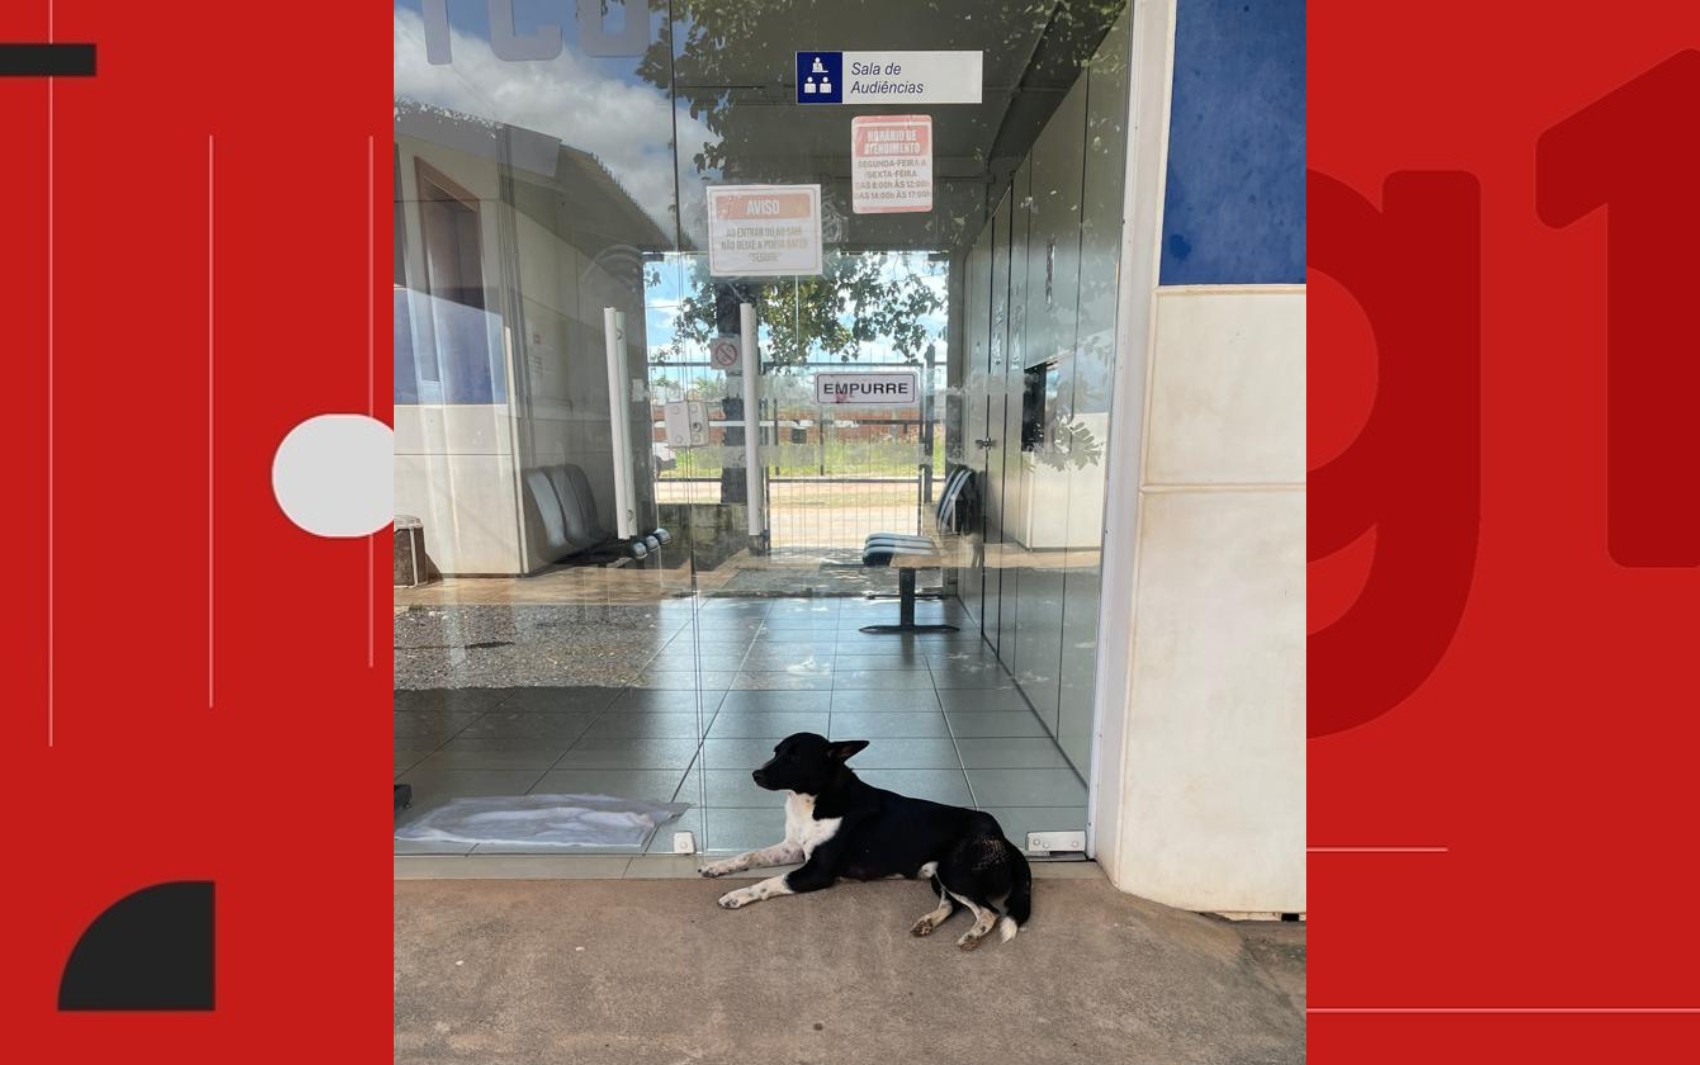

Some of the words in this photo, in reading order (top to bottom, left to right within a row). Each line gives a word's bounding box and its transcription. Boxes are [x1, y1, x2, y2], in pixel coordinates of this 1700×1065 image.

[851, 62, 881, 76] Sala
[885, 62, 902, 76] de
[850, 79, 924, 94] Audiências
[864, 142, 921, 155] ATENDIMENTO
[746, 199, 780, 216] AVISO
[823, 382, 909, 395] EMPURRE
